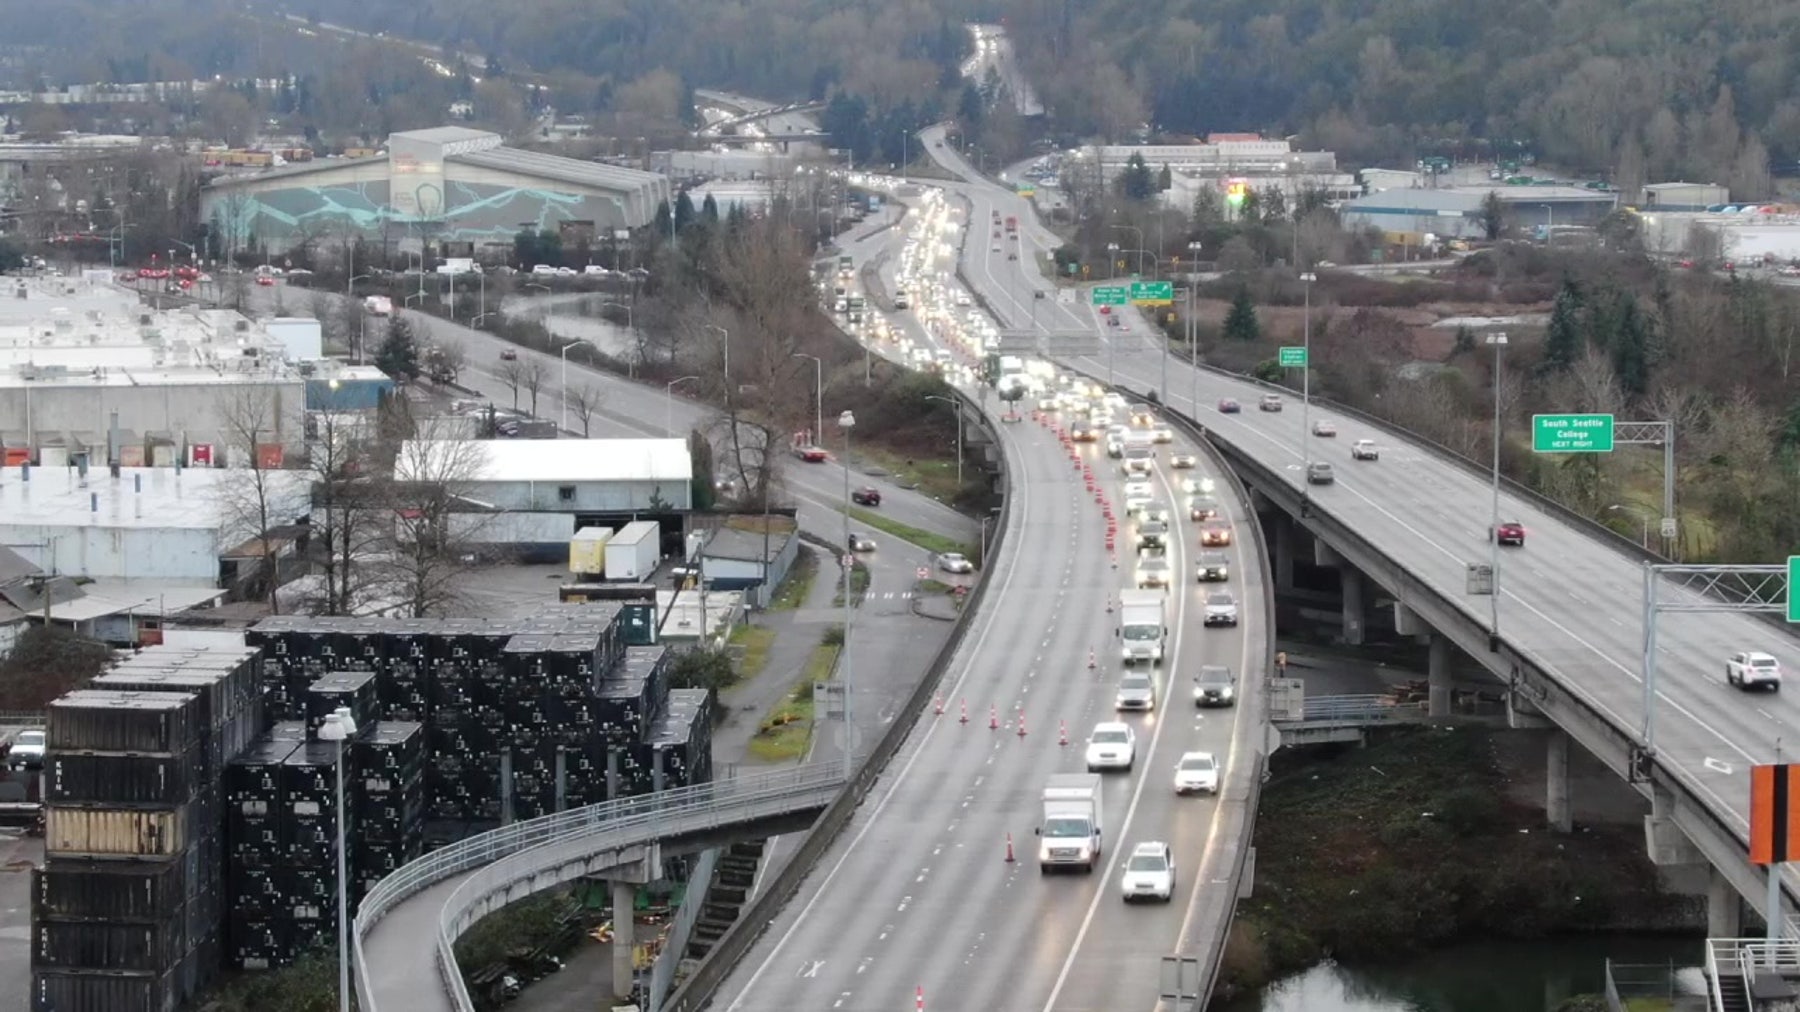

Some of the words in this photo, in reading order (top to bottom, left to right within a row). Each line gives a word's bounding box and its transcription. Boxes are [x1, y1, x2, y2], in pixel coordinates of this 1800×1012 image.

[1542, 419, 1568, 428] South
[1572, 419, 1604, 427] Seattle
[1557, 430, 1589, 440] College
